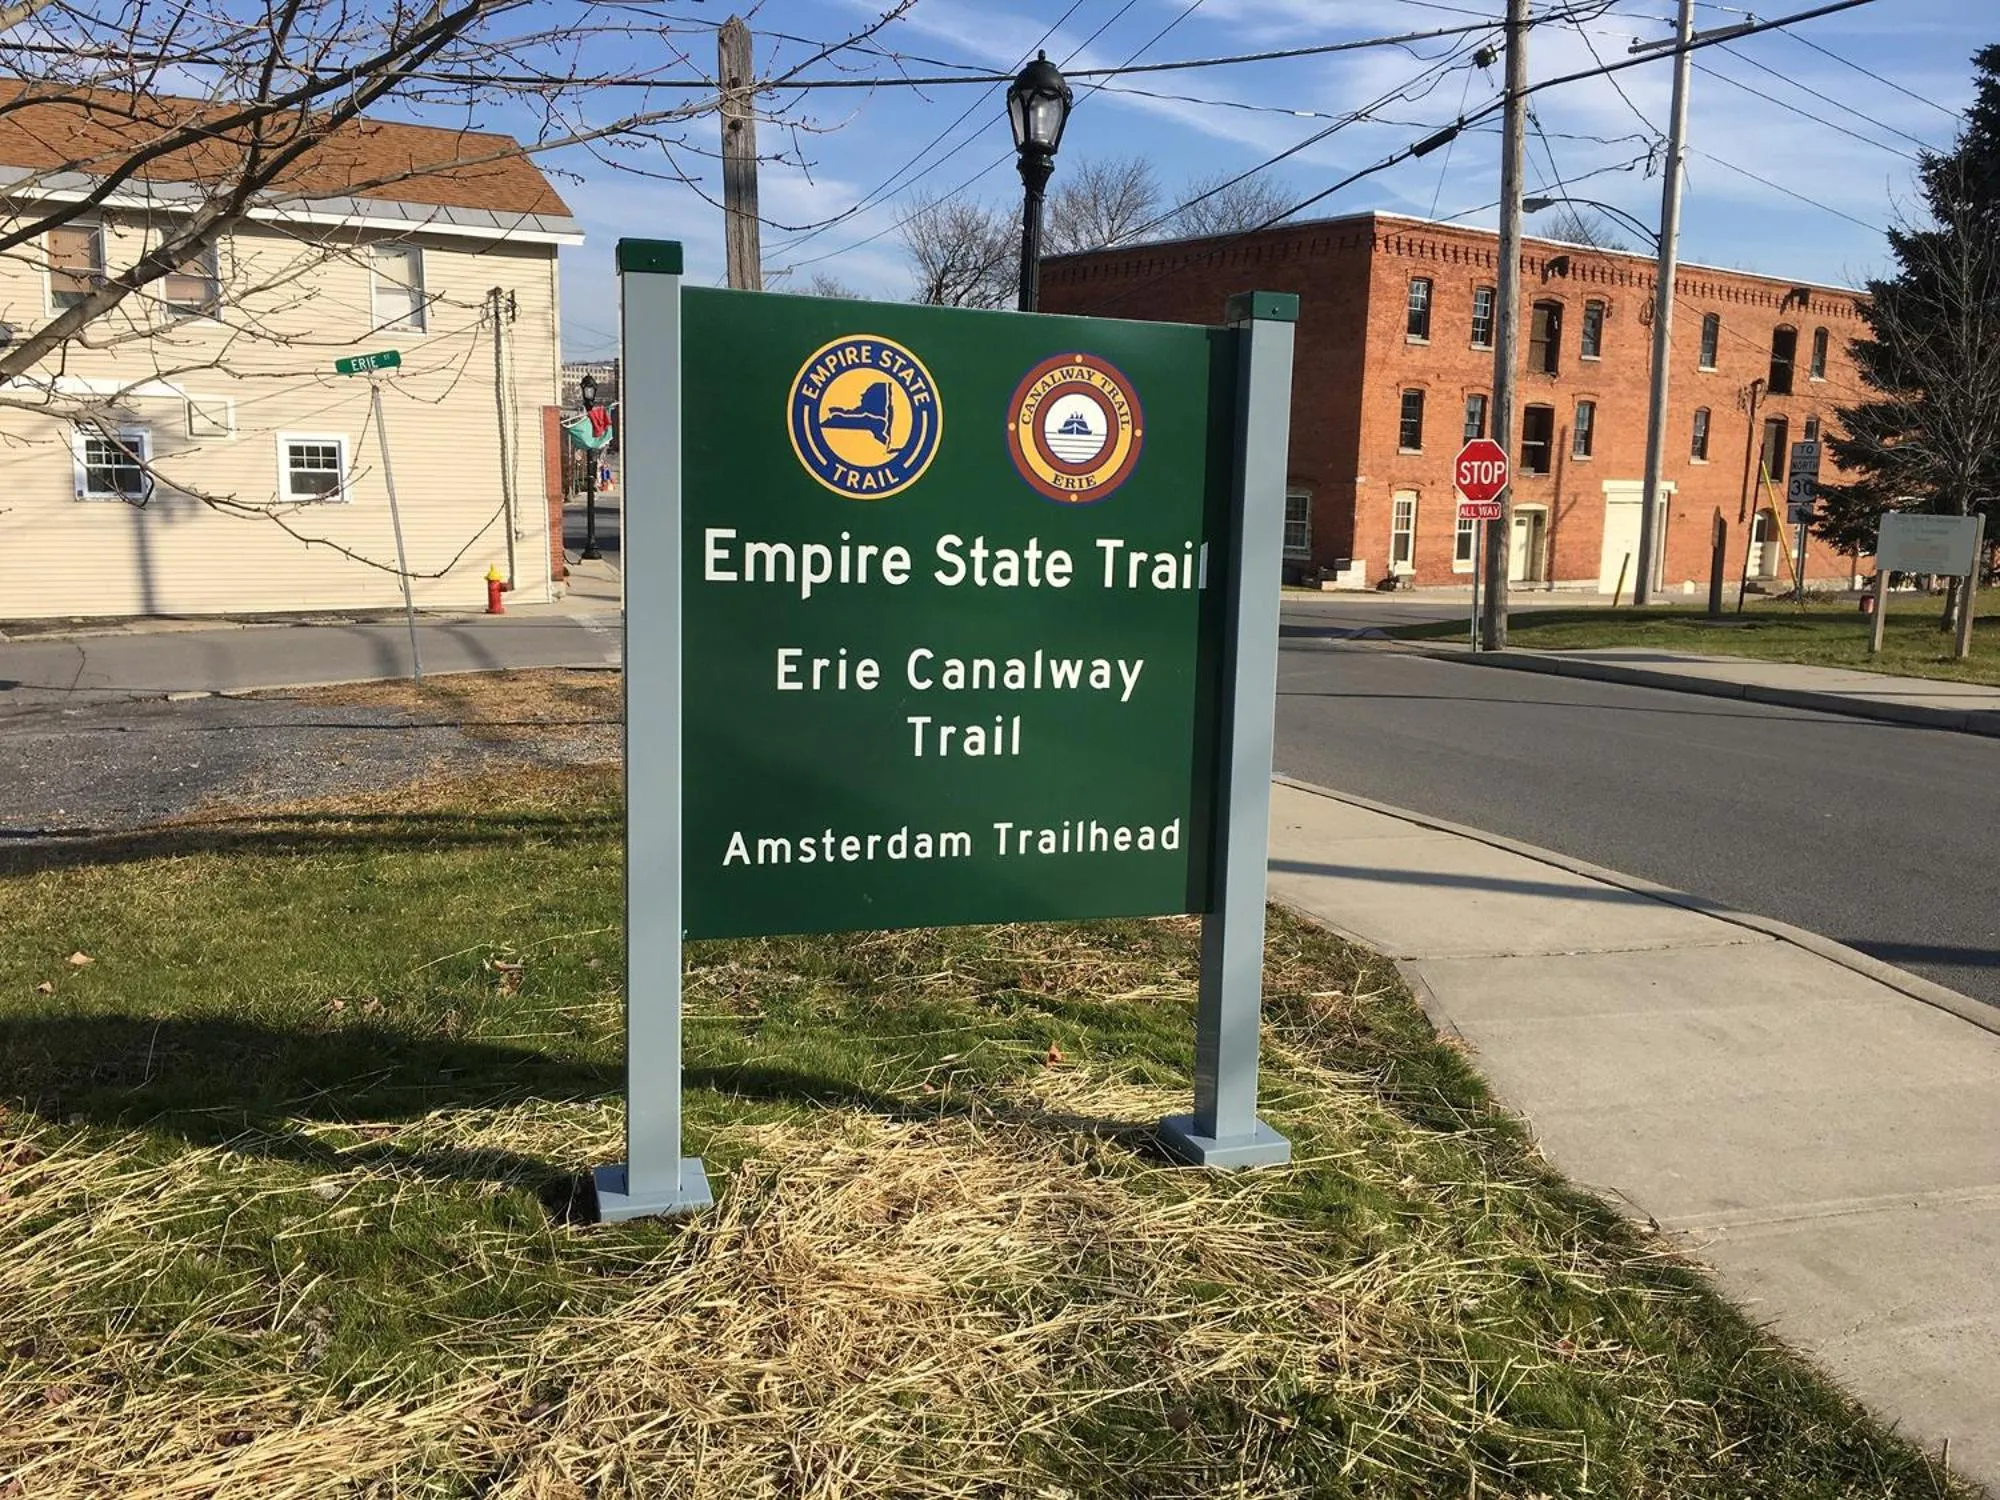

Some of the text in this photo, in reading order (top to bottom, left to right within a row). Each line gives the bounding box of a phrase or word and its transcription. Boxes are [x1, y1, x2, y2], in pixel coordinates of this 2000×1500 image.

[351, 356, 378, 371] ERIE
[802, 345, 931, 406] EMPIRE STATE
[1021, 367, 1130, 431] CANALWAY TRAIL
[1800, 445, 1814, 455] TO
[832, 463, 899, 490] TRAIL
[1052, 473, 1097, 489] ERIE
[1460, 461, 1506, 485] STOP
[1460, 506, 1500, 517] ALL WAY
[704, 527, 1209, 600] Empire State Trail
[776, 647, 1144, 702] Erie Canalway
[907, 715, 1021, 757] Trail
[722, 818, 1180, 866] Amsterdam Trailhead
